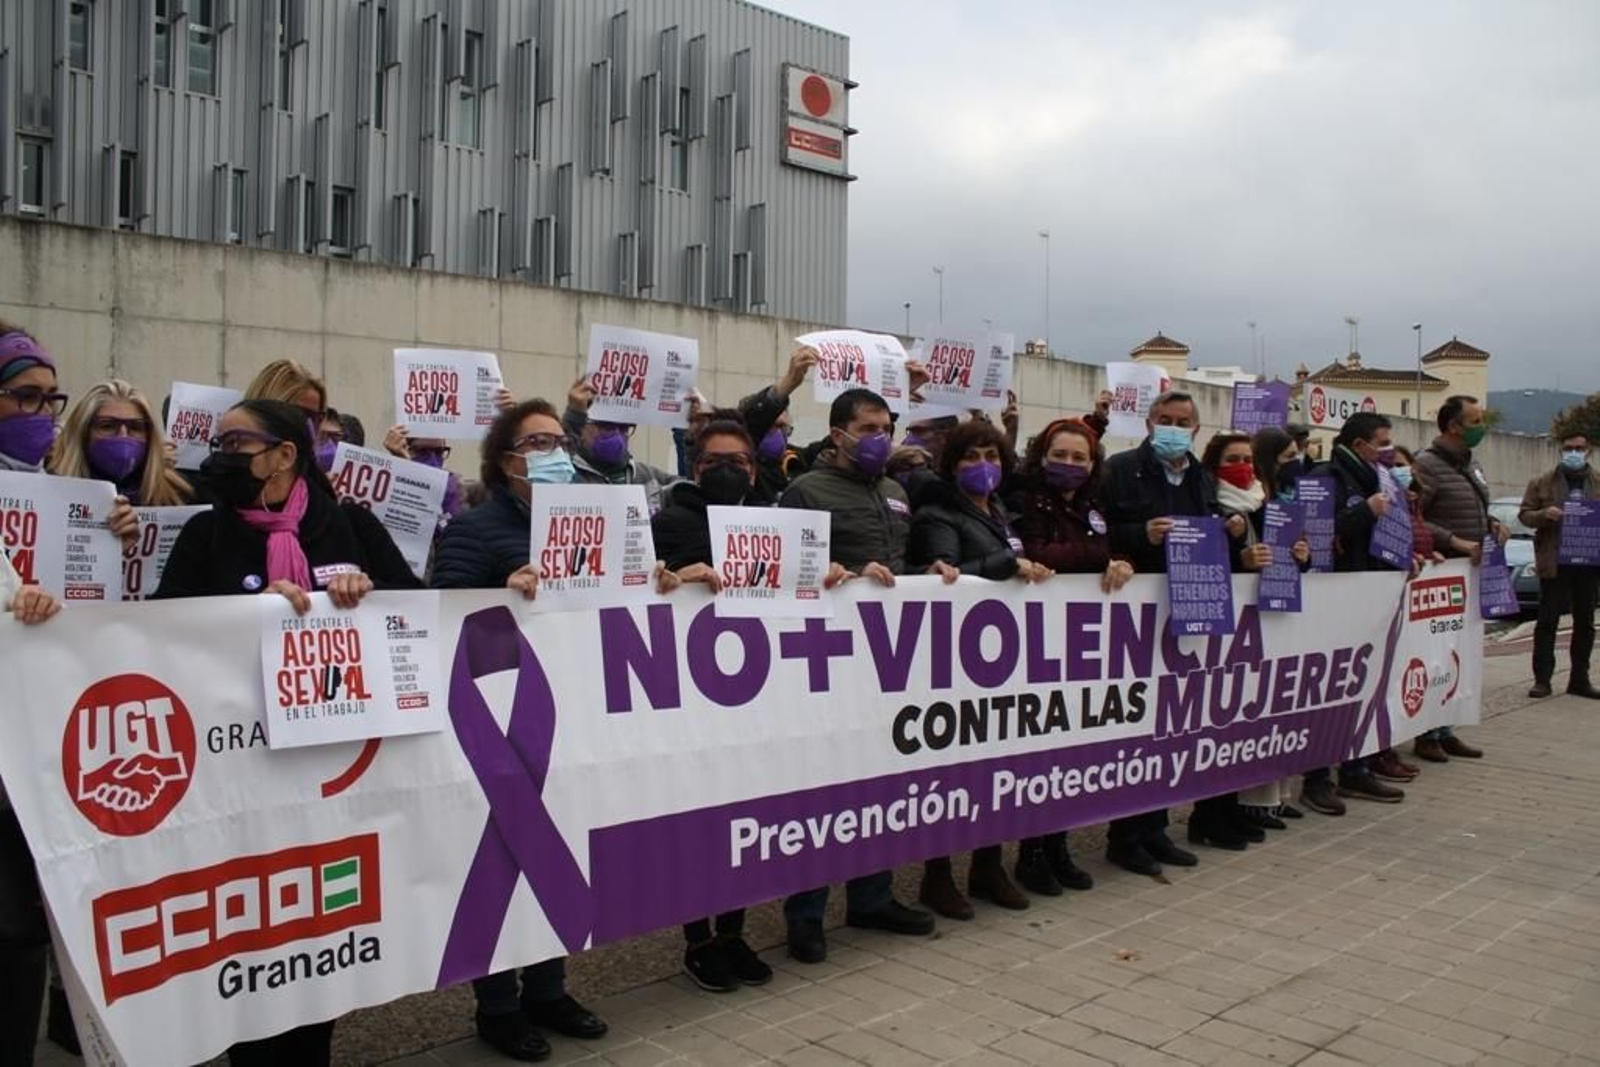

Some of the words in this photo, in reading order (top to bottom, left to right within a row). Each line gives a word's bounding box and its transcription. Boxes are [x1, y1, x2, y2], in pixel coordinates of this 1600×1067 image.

[599, 349, 649, 377] ACOSO
[819, 342, 864, 362] ACOSO
[930, 345, 975, 368] ACOSO
[408, 371, 459, 393] ACOSO
[821, 359, 869, 384] SEXUAL
[592, 372, 646, 400] SEXUAL
[404, 392, 461, 416] SEXUAL
[175, 411, 213, 428] ACOSO
[24, 499, 34, 510] EL
[547, 516, 605, 547] ACOSO
[726, 533, 782, 561] ACOSO
[1169, 544, 1190, 563] LAS
[540, 546, 605, 579] SEXUAL
[722, 560, 781, 588] SEXUAL
[1170, 563, 1225, 582] MUJERES
[67, 589, 96, 598] CCOO
[1171, 583, 1229, 601] TENEMOS
[1411, 586, 1449, 613] CCOO
[282, 618, 306, 631] CCOO
[310, 617, 342, 629] CONTRA
[344, 616, 353, 627] EL
[1186, 622, 1203, 632] UGT
[283, 628, 362, 667] ACOSO
[277, 664, 372, 708] SEXUAL
[893, 690, 1070, 755] CONTRA
[1081, 682, 1147, 728] LAS
[1154, 643, 1373, 740] MUJERES
[286, 708, 299, 720] EN
[305, 707, 316, 719] EL
[322, 702, 365, 716] TRABAJO
[77, 697, 176, 768] UGT
[207, 720, 268, 753] GRA
[730, 779, 980, 868] Prevención,
[992, 748, 1163, 813] Protección
[1169, 745, 1188, 787] y
[1195, 725, 1310, 771] Derechos
[105, 866, 314, 976] CCOO
[218, 931, 381, 1000] Granada
